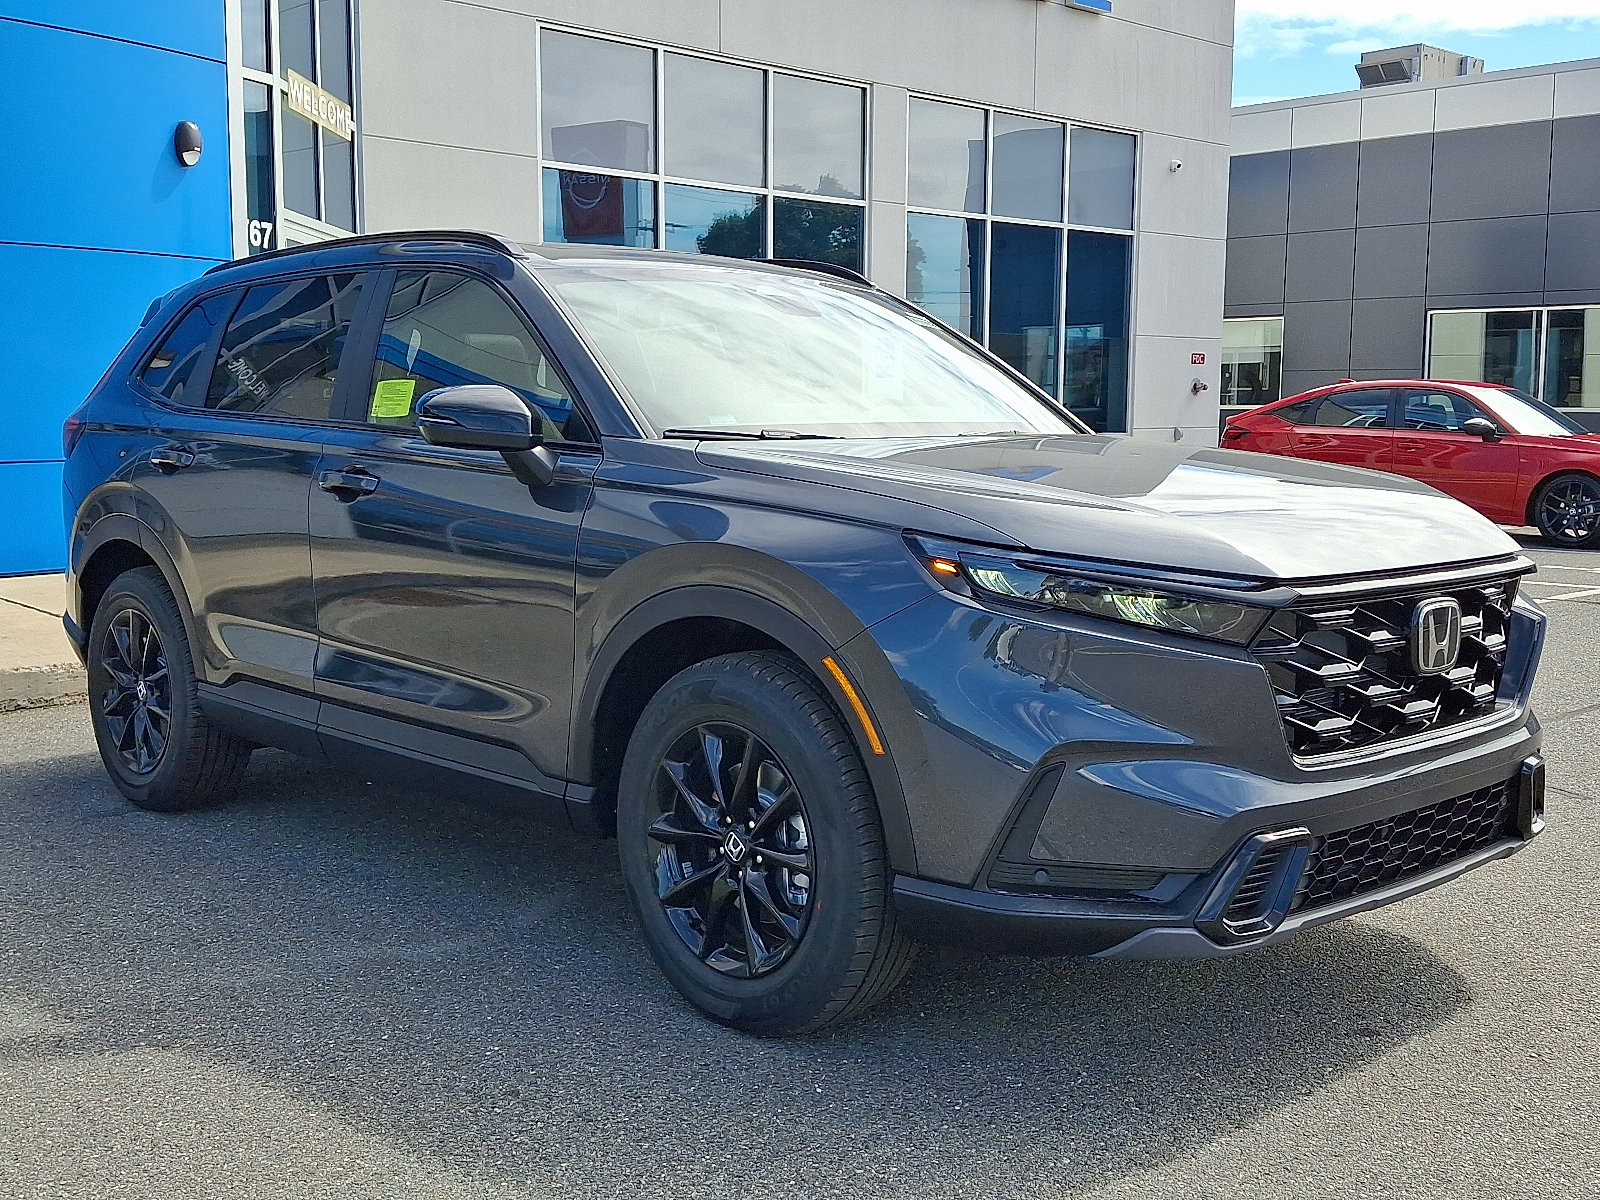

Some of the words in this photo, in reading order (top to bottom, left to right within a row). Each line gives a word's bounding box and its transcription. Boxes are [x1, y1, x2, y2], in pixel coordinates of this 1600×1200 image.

[288, 75, 351, 135] WELCOME
[247, 218, 273, 249] 67
[1192, 354, 1204, 364] FDC
